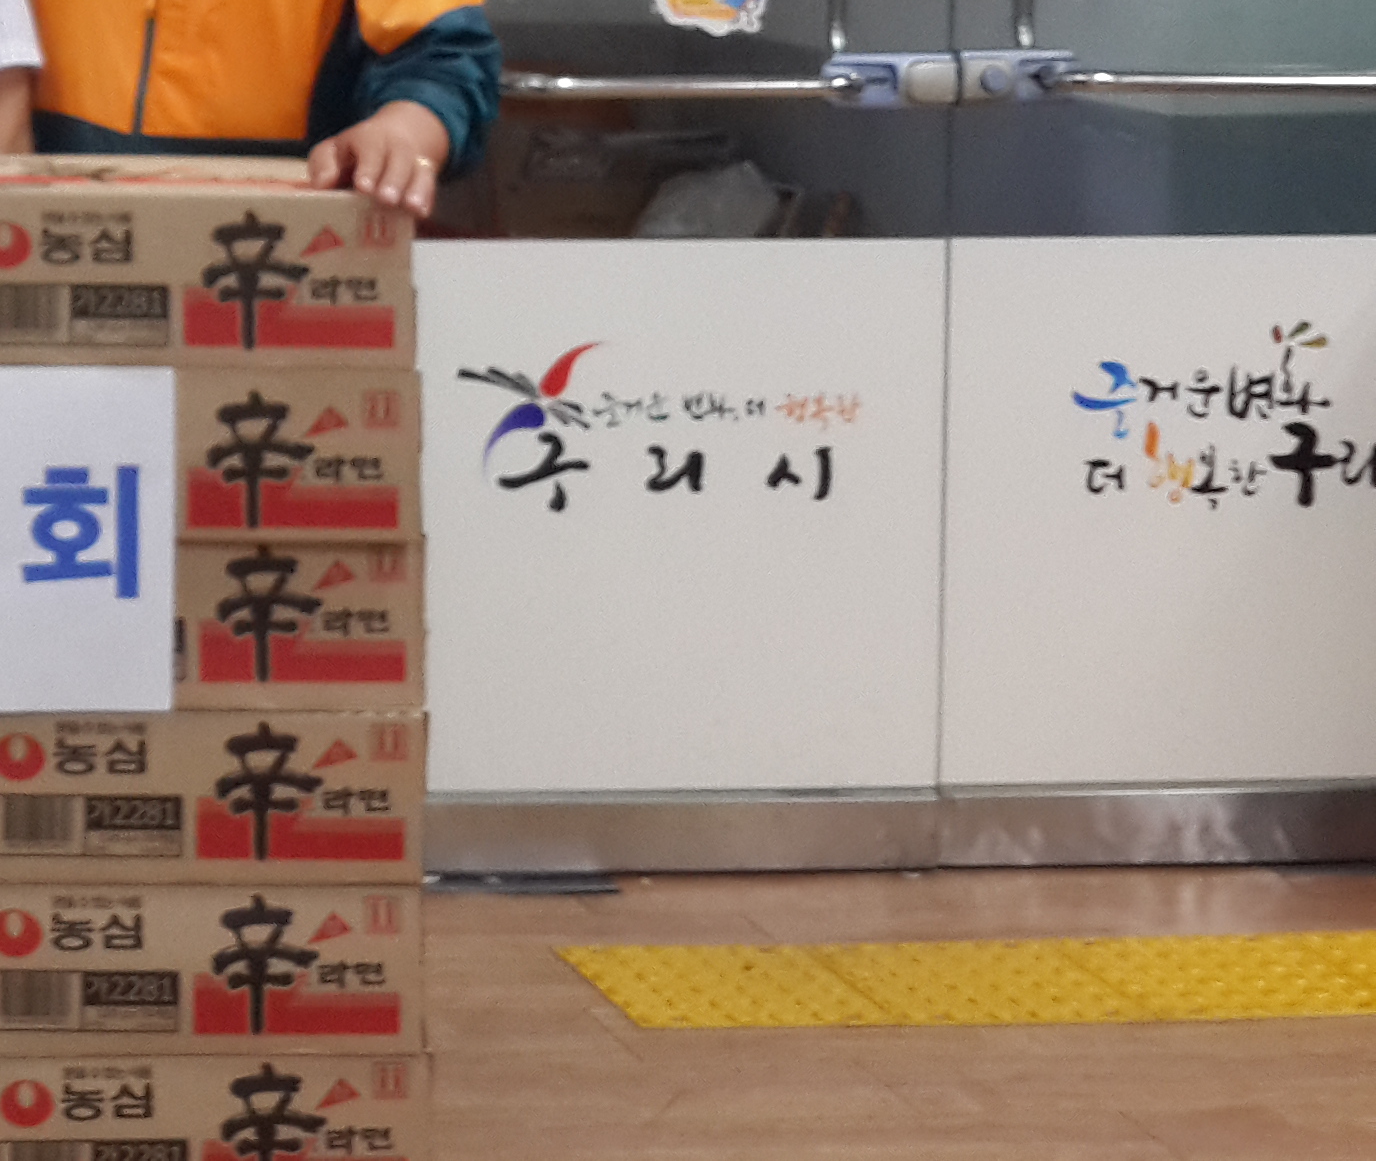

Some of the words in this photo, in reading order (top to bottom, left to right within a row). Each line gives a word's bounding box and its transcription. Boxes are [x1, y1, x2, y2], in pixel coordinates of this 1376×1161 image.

[40, 227, 134, 265] 농심
[202, 210, 310, 351] 辛
[206, 389, 316, 529] 辛
[498, 431, 832, 513] 구리시
[1083, 458, 1126, 495] 더
[216, 543, 323, 683] 辛
[54, 739, 147, 776] 농심
[215, 721, 324, 861] 辛
[51, 912, 144, 952] 농심
[212, 893, 319, 1035] 辛
[61, 1083, 154, 1122] 농심
